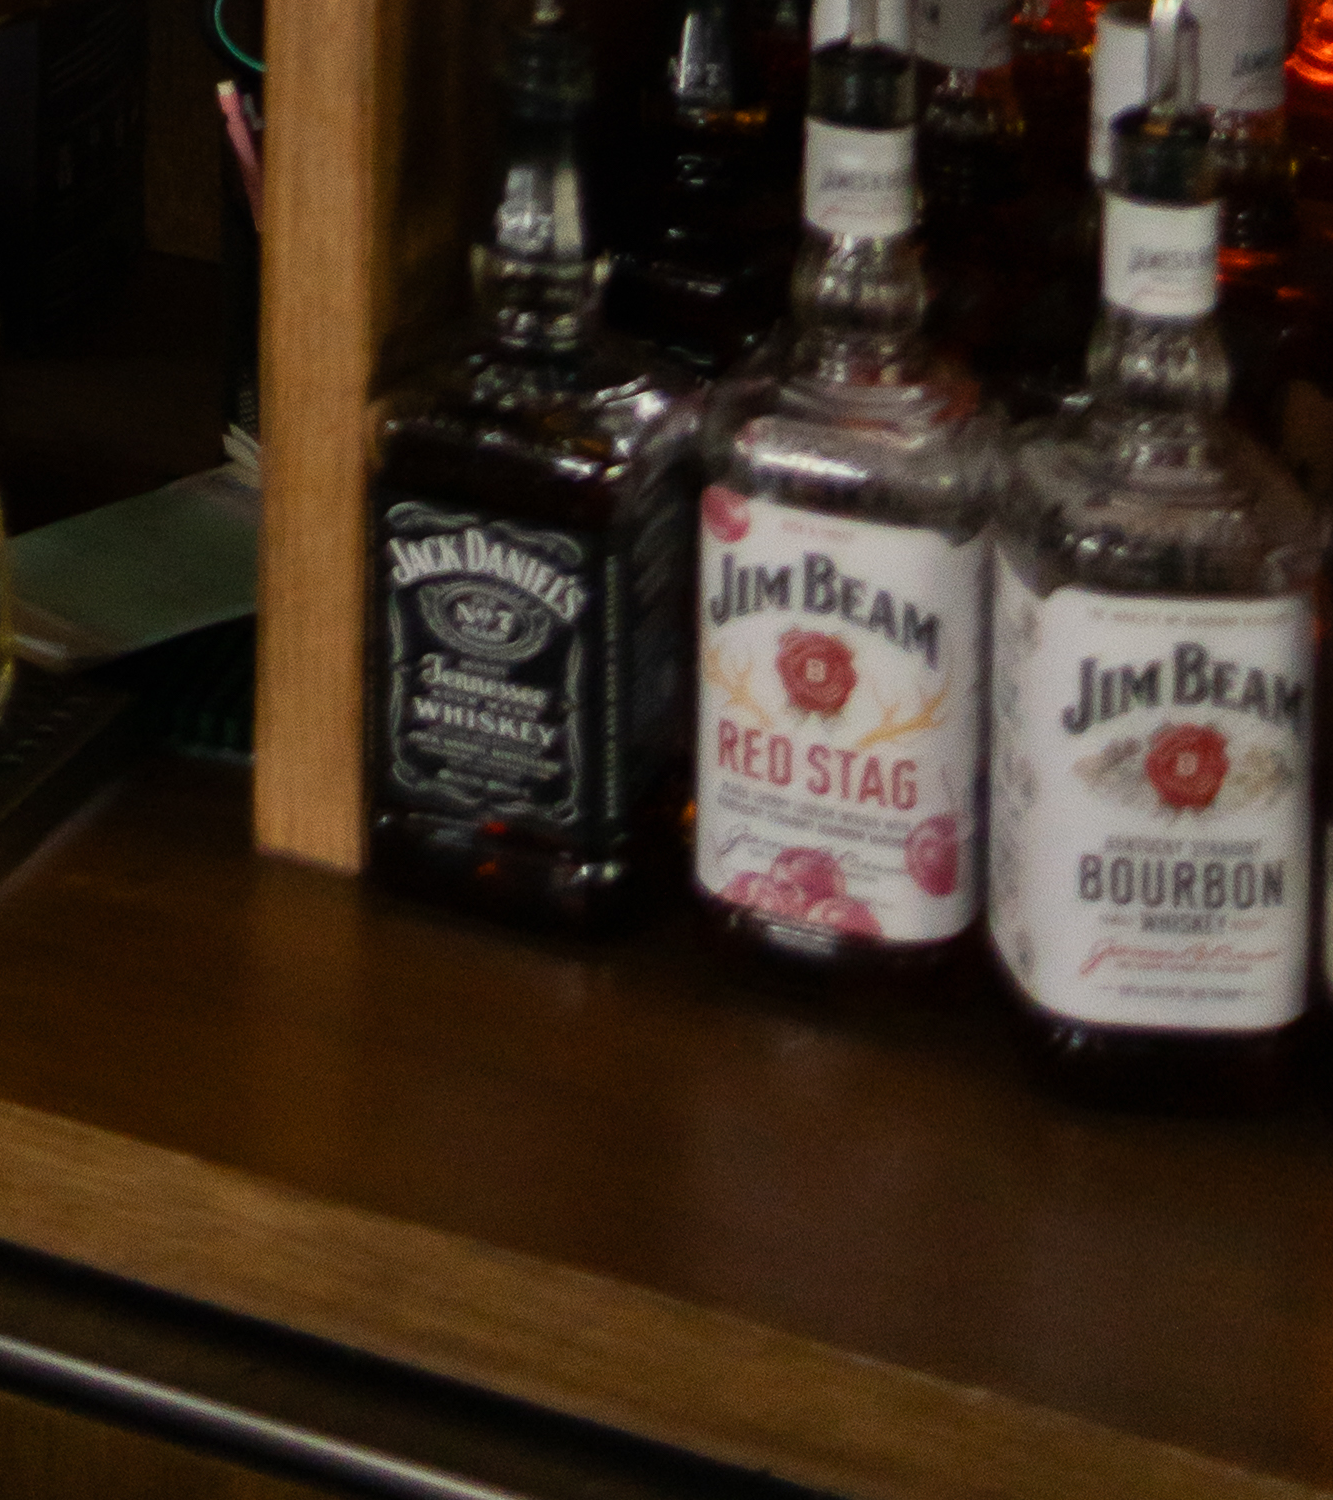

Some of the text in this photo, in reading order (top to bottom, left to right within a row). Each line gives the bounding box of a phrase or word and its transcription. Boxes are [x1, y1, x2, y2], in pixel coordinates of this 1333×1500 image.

[388, 535, 460, 586] JACK
[463, 528, 586, 624] DANIEL'S
[708, 553, 941, 670] JIM BEAM
[414, 697, 558, 747] WHISKEY
[1064, 642, 1305, 735] JIM BEAM
[717, 720, 918, 810] RED STAG
[1078, 854, 1284, 910] BOURBON
[1141, 911, 1226, 936] WHISKEY
